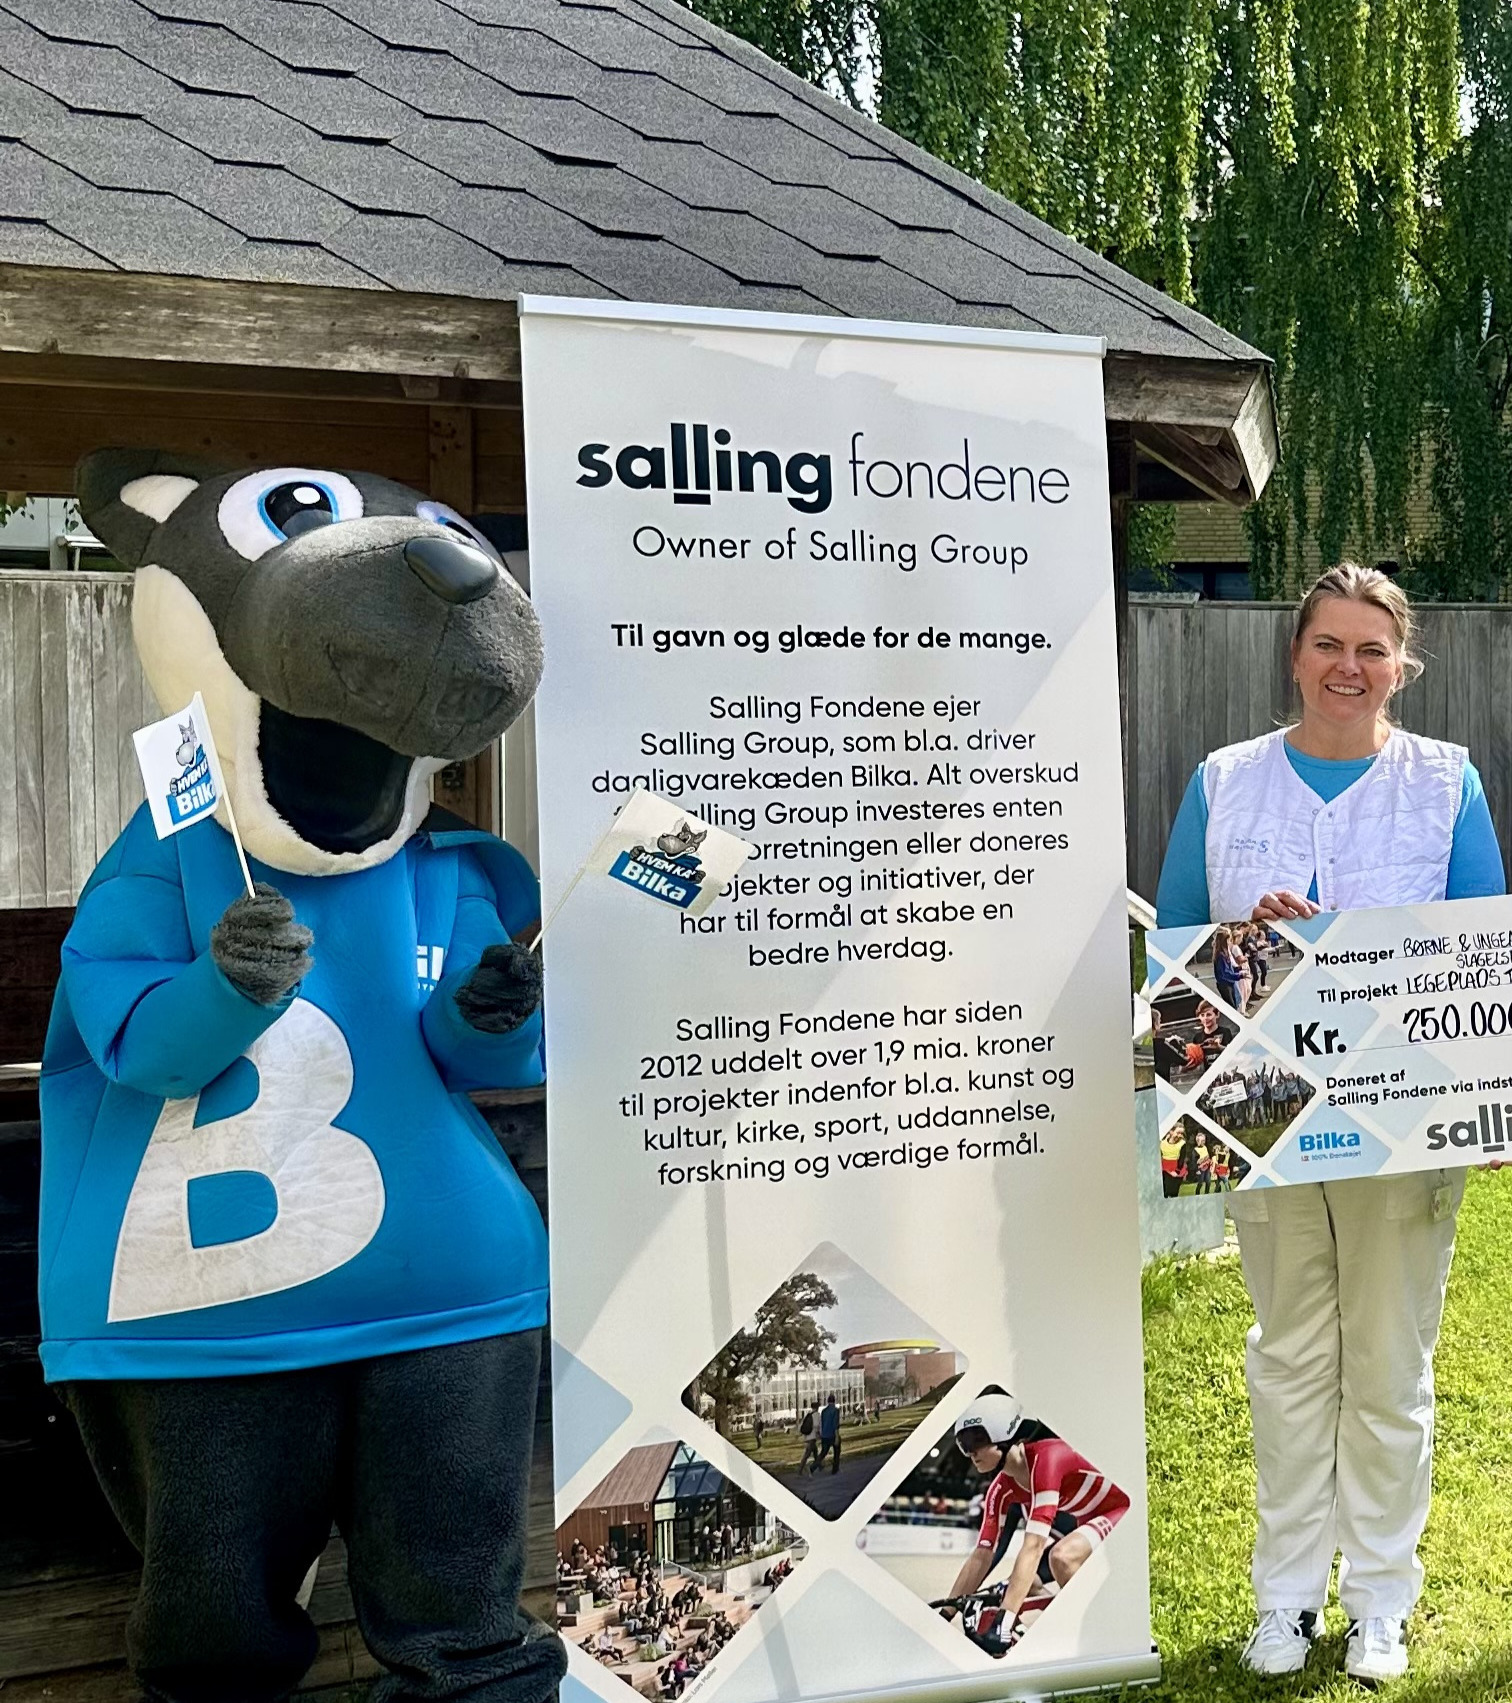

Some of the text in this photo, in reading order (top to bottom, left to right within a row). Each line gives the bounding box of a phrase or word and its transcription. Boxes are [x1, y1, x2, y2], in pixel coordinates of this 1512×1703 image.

[575, 422, 1070, 515] salling fondene
[632, 525, 1028, 574] Owner of Salling Group
[610, 623, 1052, 655] Til gavn og glæde for de mange.
[709, 694, 981, 725] Salling Fondene ejer
[640, 728, 1036, 761] Salling Group, som bl.a. driver
[851, 763, 919, 788] Bilka.
[926, 762, 962, 786] Alt
[969, 761, 1079, 785] overskud
[686, 797, 1063, 831] lling Group investeres enten
[741, 830, 1069, 863] orretningen eller doneres
[637, 852, 675, 875] HVEM
[621, 860, 687, 902] Bilka
[718, 863, 1035, 903] ojekter og initiativer, der
[680, 900, 1013, 935] har til formål at skabe en
[748, 936, 953, 967] bedre hverdag.
[1314, 949, 1395, 967] Modtager
[1403, 936, 1453, 958] BØRNE
[1458, 932, 1471, 950] &
[1317, 983, 1399, 1005] Til projekt
[1406, 968, 1501, 995] LEGEPLADS
[676, 1000, 1022, 1043] Salling Fondene har siden
[1293, 1021, 1347, 1058] Kr.
[640, 1035, 1056, 1080] 2012 uddelt over 1,9 mia. kroner
[618, 1067, 1074, 1121] til projekter indenfor bl.a. kunst og
[1326, 1069, 1406, 1090] Doneret af
[1327, 1091, 1379, 1107] Salling
[1383, 1086, 1448, 1102] Fondene
[1450, 1081, 1475, 1094] via
[644, 1099, 1056, 1152] kultur, kirke, sport, uddannelse,
[1299, 1132, 1361, 1152] Bilka
[107, 997, 387, 1324] B
[657, 1131, 1045, 1186] forskning og værdige formål.
